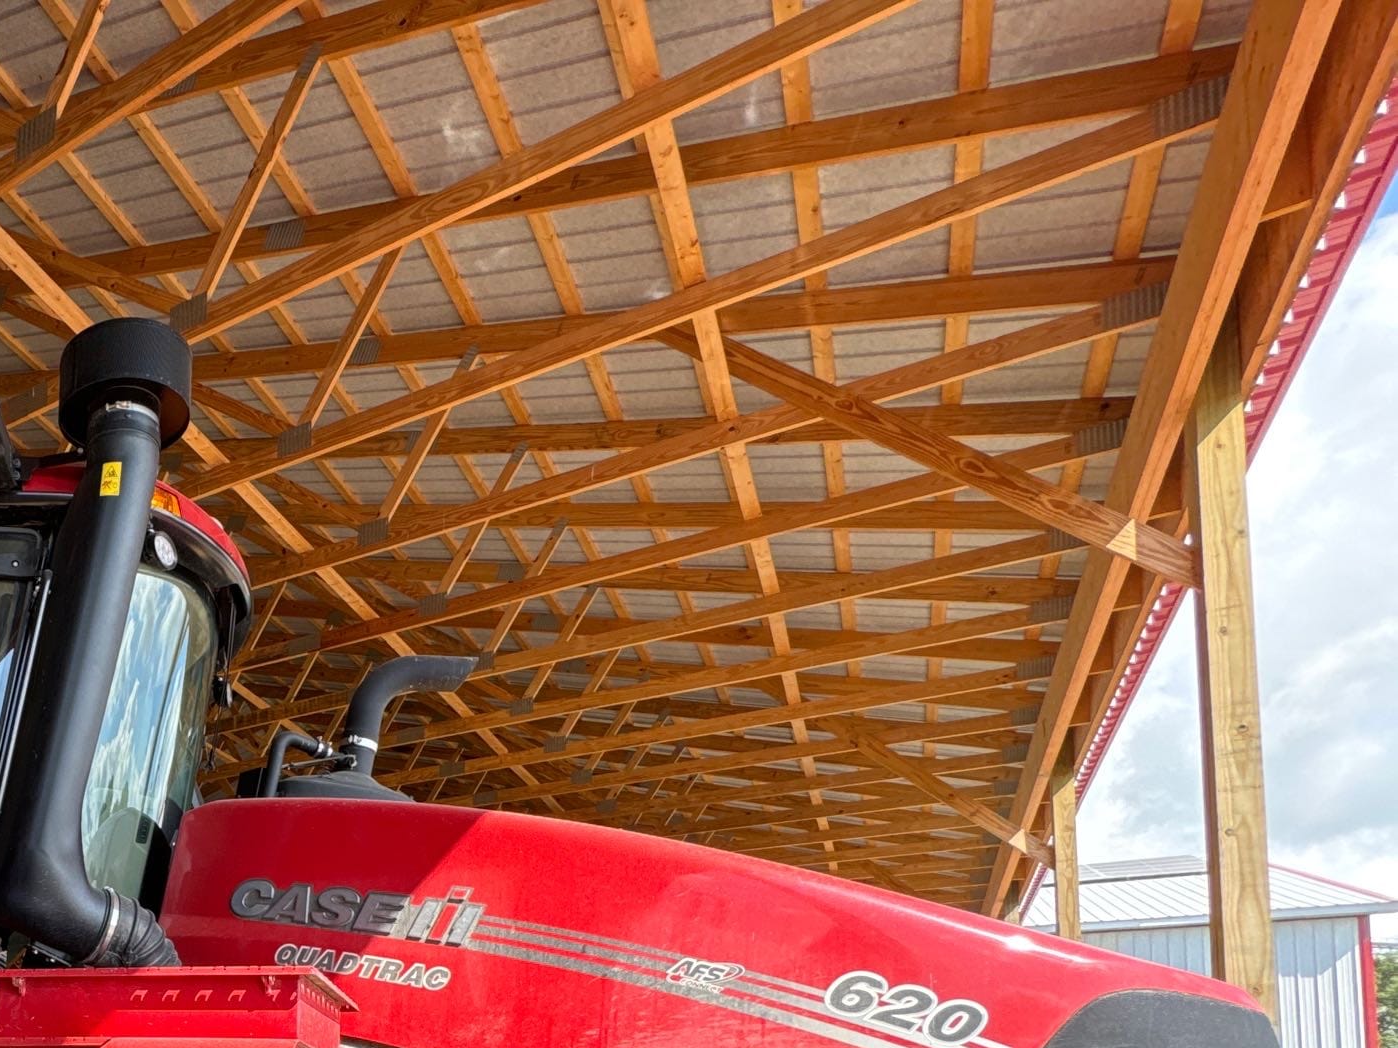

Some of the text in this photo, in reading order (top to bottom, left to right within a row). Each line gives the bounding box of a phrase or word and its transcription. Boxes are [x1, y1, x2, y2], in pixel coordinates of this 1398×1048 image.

[231, 878, 410, 937] CASE
[275, 944, 451, 990] QUADTRAC
[666, 958, 728, 983] AFS
[824, 970, 988, 1047] 620
